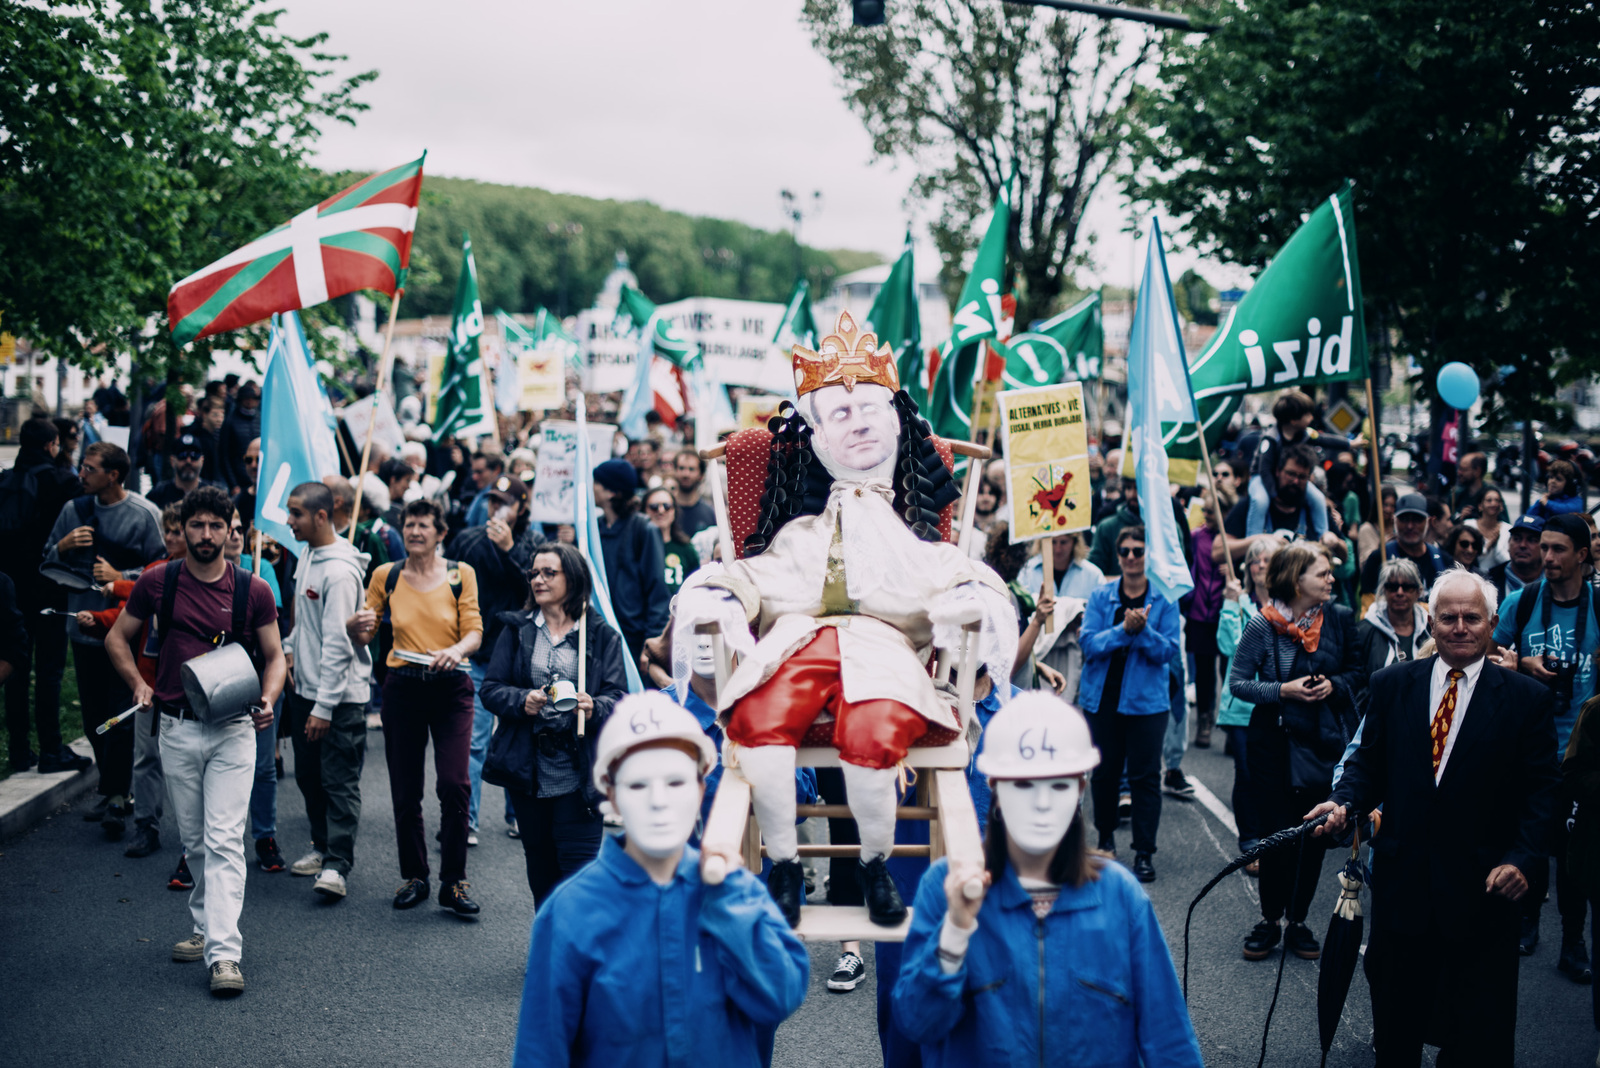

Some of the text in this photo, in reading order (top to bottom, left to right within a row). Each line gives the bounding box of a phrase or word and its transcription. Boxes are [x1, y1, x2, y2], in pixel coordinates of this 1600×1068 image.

[1010, 399, 1079, 420] ALTERNATIVES VIE
[630, 708, 660, 735] 64
[1018, 726, 1057, 761] 64
